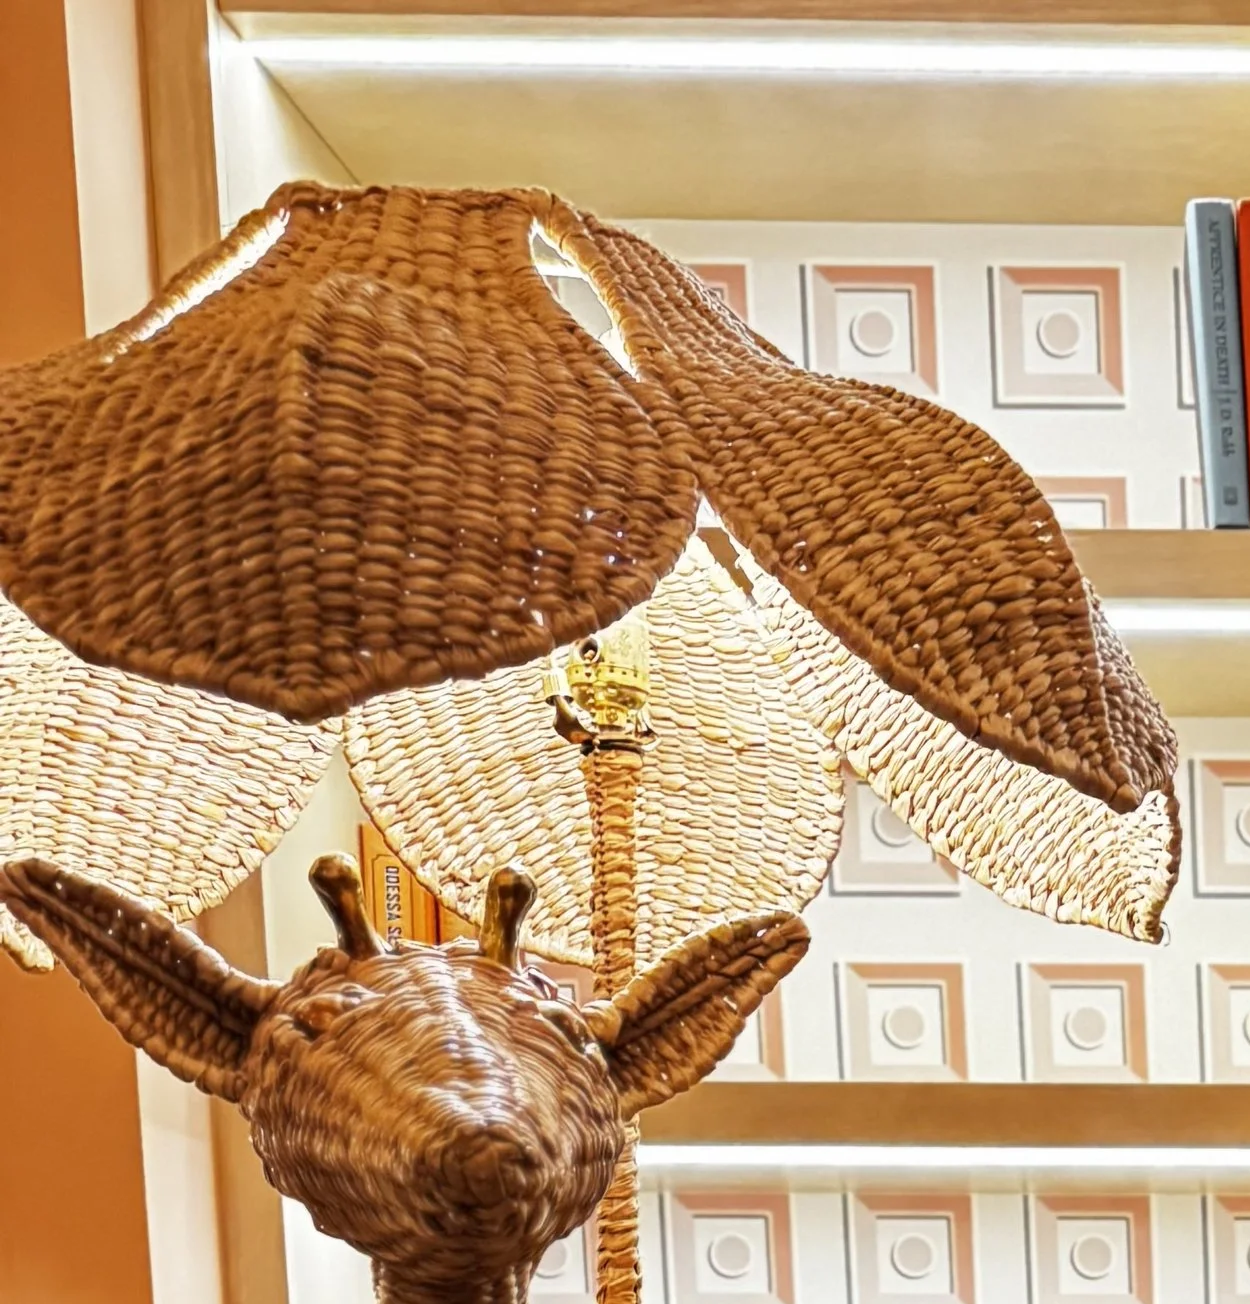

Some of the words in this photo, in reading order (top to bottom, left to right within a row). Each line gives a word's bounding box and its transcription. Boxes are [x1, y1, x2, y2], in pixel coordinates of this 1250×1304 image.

[1207, 219, 1229, 314] APPRENTICE
[1215, 317, 1227, 333] IN
[1215, 336, 1231, 385] DEATH
[386, 866, 401, 921] ODESSA
